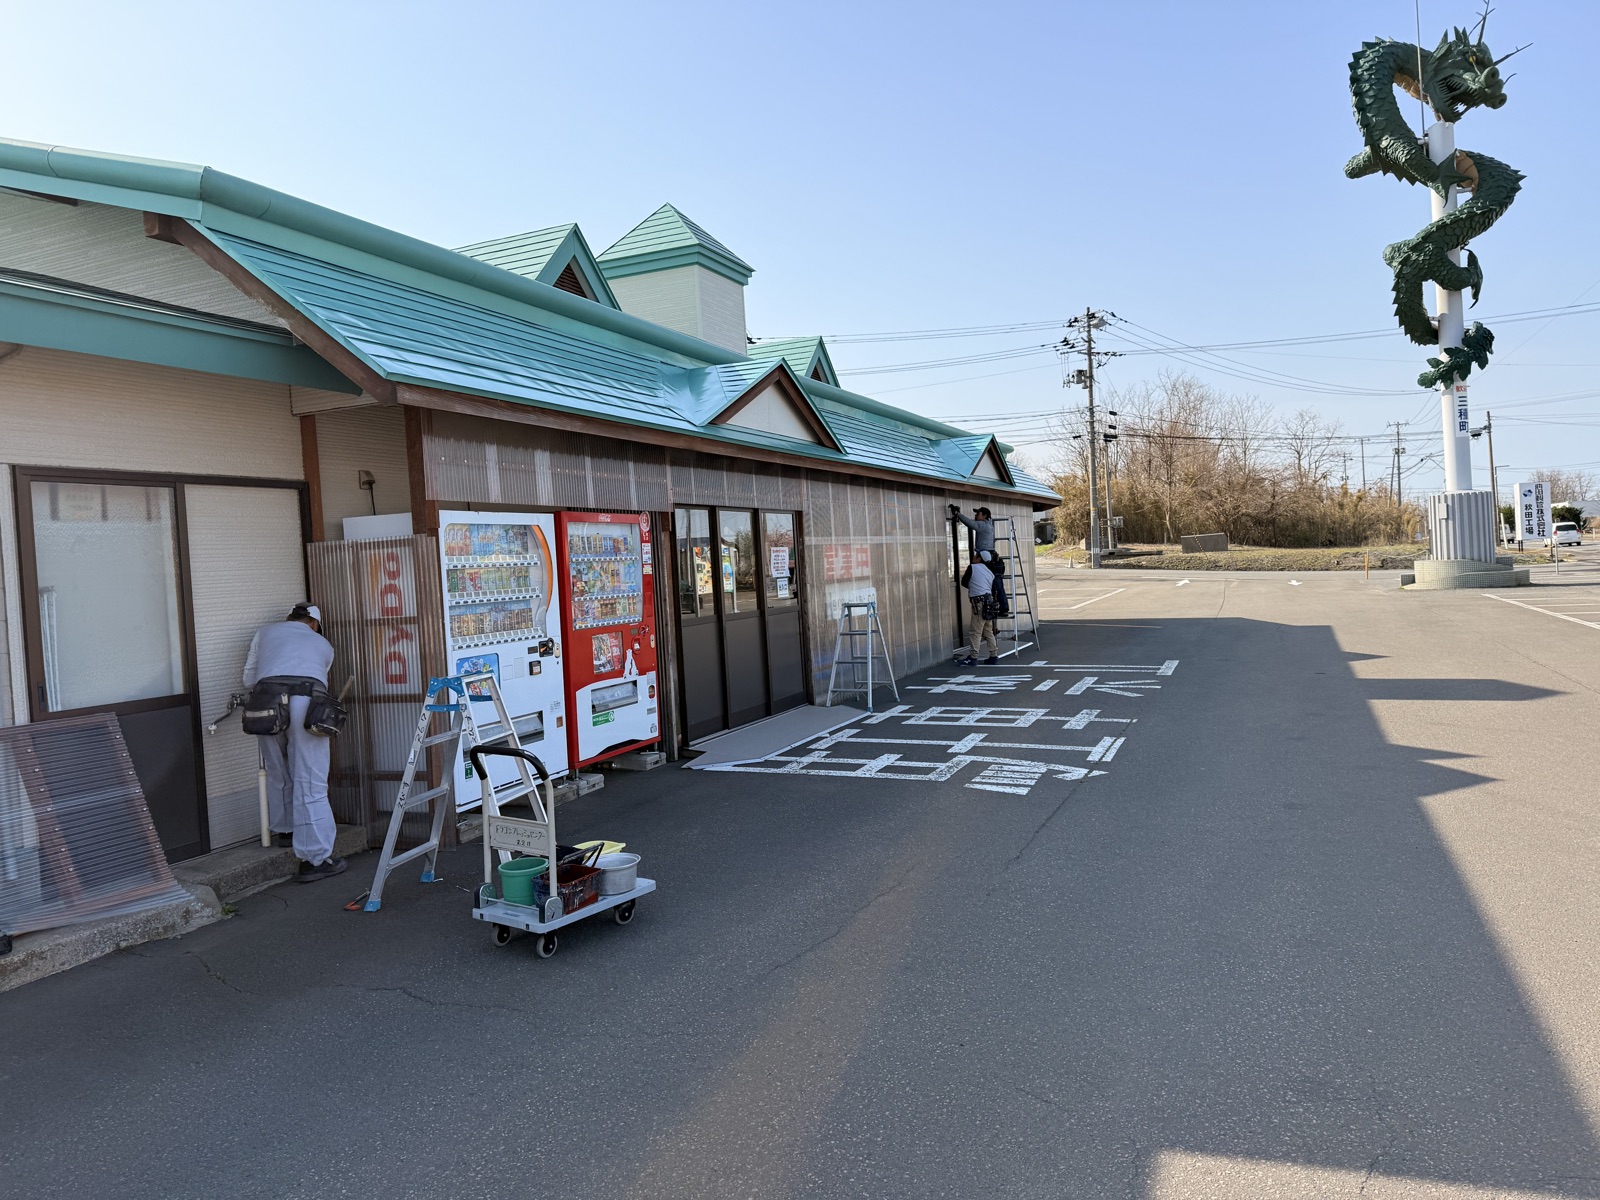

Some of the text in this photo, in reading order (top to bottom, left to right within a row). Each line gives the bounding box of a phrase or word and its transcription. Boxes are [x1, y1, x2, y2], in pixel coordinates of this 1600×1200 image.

[1457, 395, 1469, 433] 三種町
[1524, 503, 1534, 535] 秋田工場
